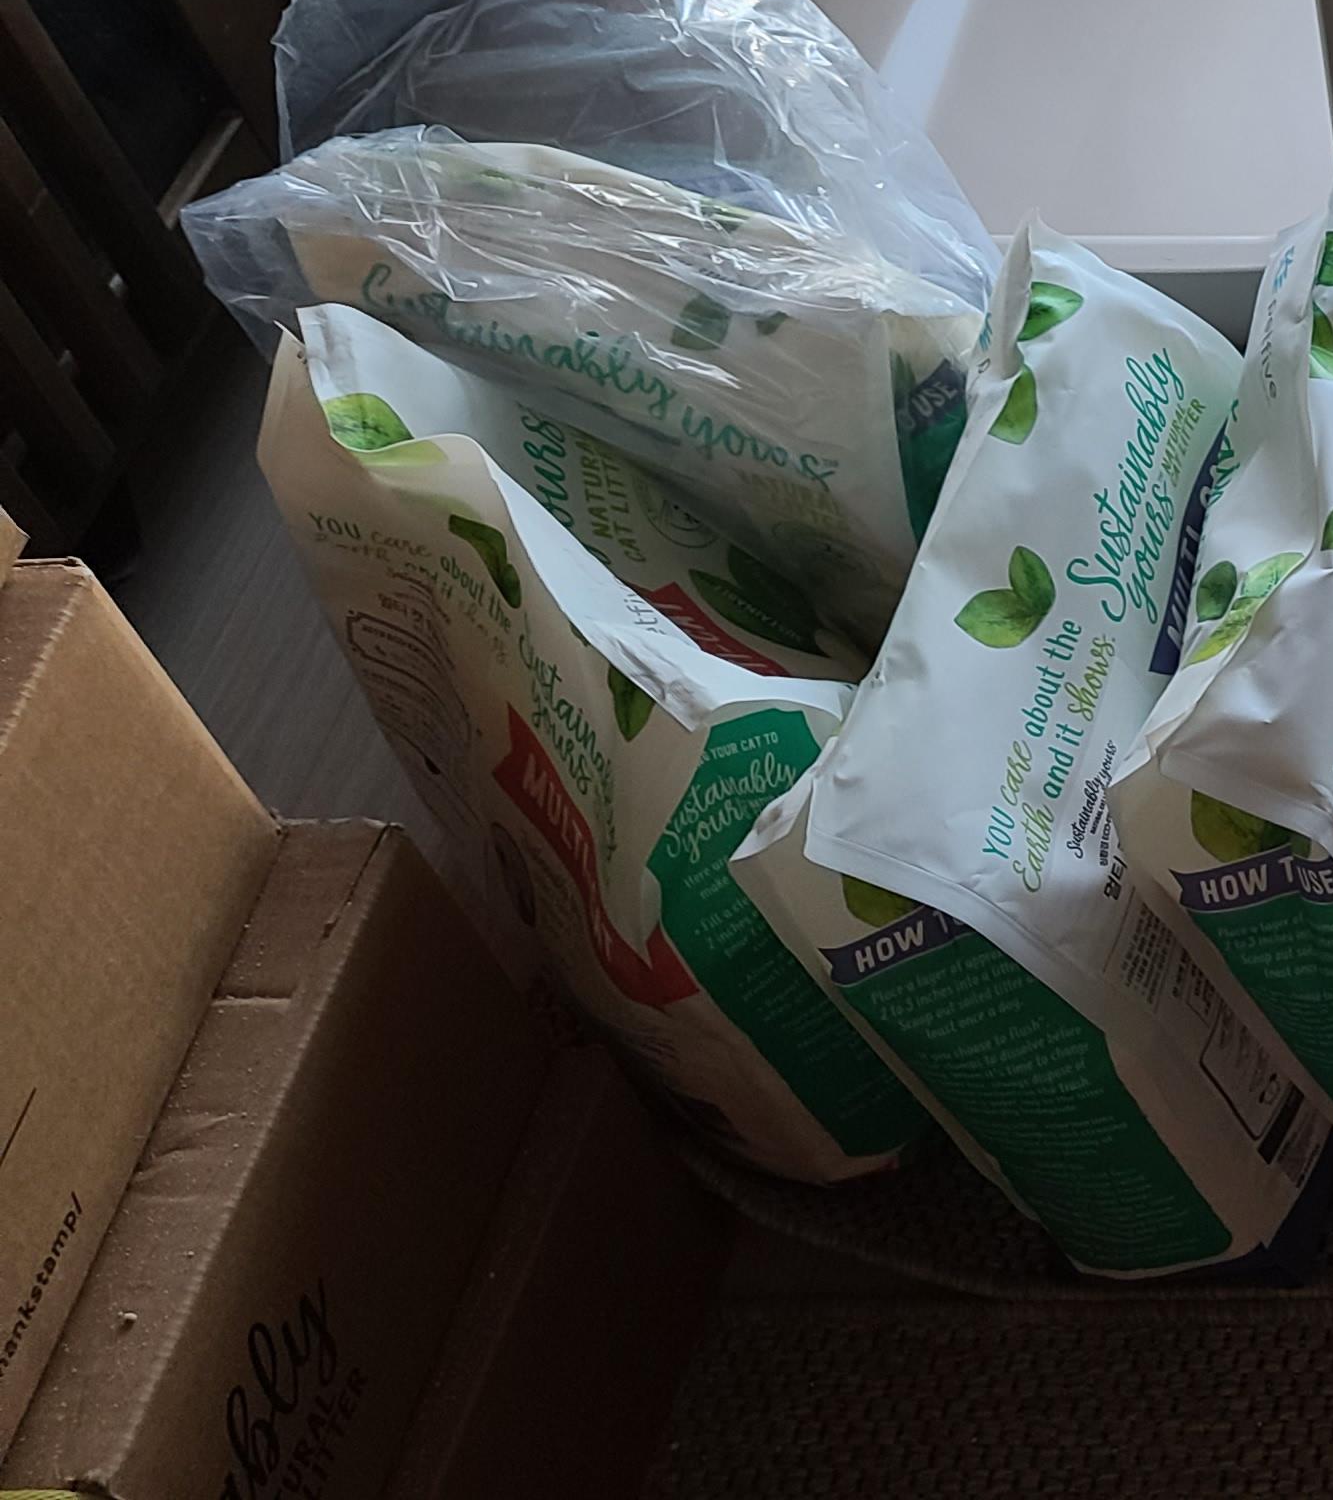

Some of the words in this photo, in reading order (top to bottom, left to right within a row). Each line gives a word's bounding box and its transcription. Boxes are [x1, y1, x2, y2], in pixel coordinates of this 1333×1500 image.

[911, 381, 958, 418] USE
[1178, 397, 1206, 457] LITTER
[1161, 405, 1188, 476] NATURAL
[574, 433, 614, 540] NATURA
[603, 452, 632, 520] LITT
[1066, 347, 1185, 623] Sustainably
[308, 511, 361, 541] YOU
[439, 554, 486, 604] about
[611, 521, 647, 563] CAT
[1126, 480, 1175, 625] yours
[1043, 619, 1082, 662] the
[1021, 664, 1066, 738] about
[1055, 722, 1085, 748] it
[709, 742, 738, 761] YOUR
[740, 735, 762, 752] CAT
[762, 730, 780, 746] TO
[1000, 739, 1033, 807] care
[1042, 746, 1075, 800] and
[663, 750, 797, 859] Sustainably
[680, 794, 744, 865] your
[982, 805, 1016, 860] YOU
[1066, 775, 1103, 860] Sustainably
[1098, 739, 1117, 788] yours
[1012, 802, 1056, 893] Earth
[1103, 855, 1128, 901] 멀티
[1199, 863, 1269, 905] HOW
[1279, 855, 1296, 884] T
[854, 919, 925, 974] HOW
[0, 1190, 83, 1378] ankstamp/
